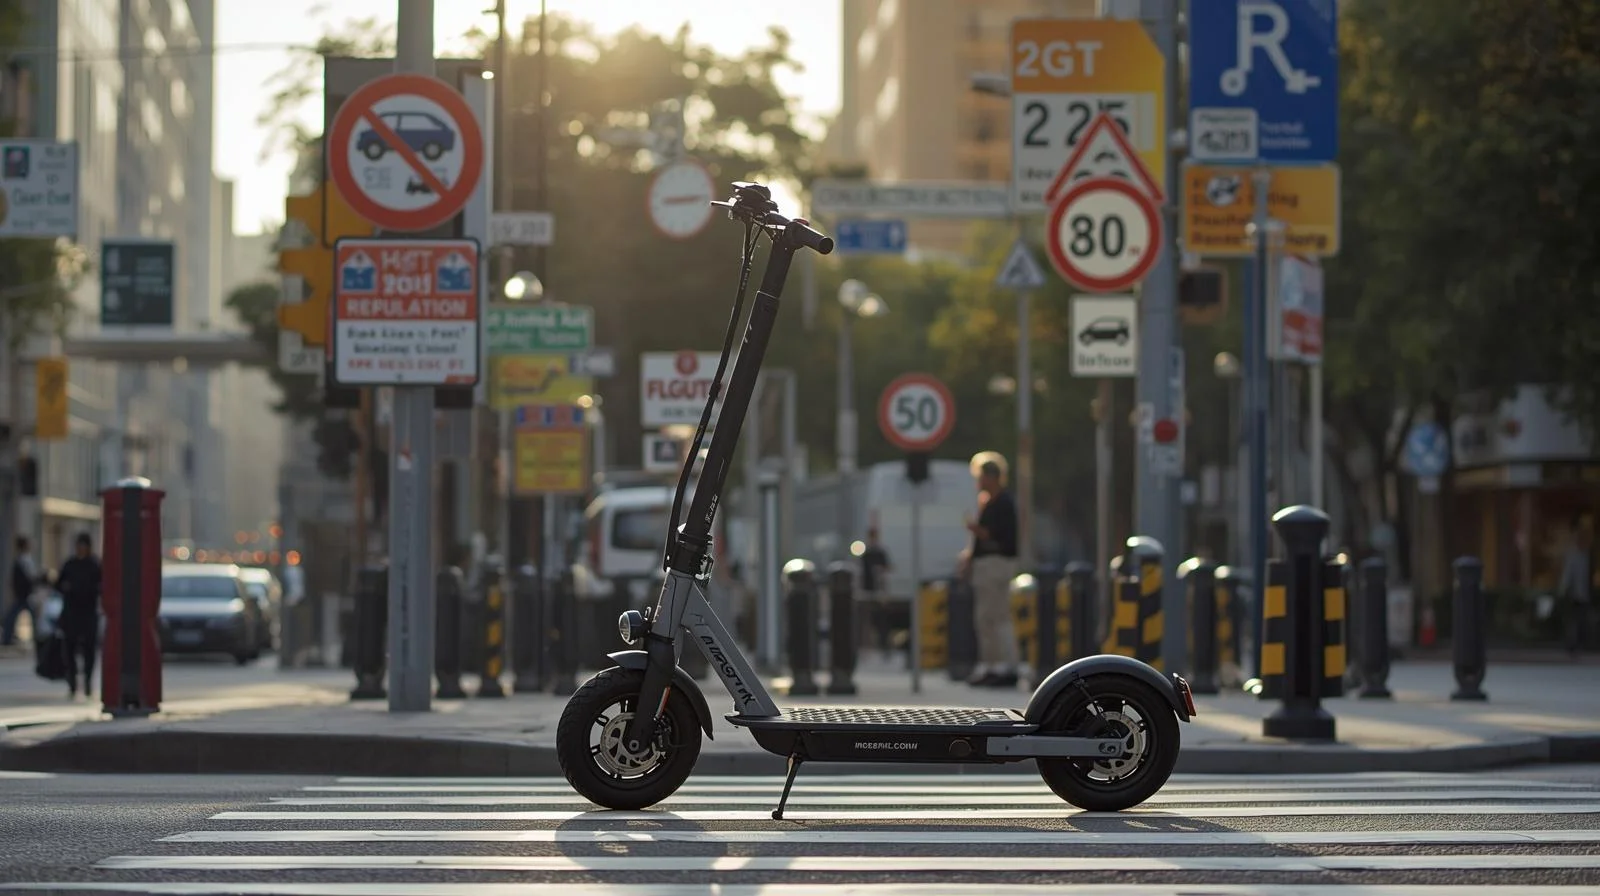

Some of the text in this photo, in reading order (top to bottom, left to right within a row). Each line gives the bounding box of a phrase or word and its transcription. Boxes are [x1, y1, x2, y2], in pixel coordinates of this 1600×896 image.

[1016, 40, 1103, 78] 2GT
[1070, 214, 1126, 257] 80
[896, 394, 938, 431] 50
